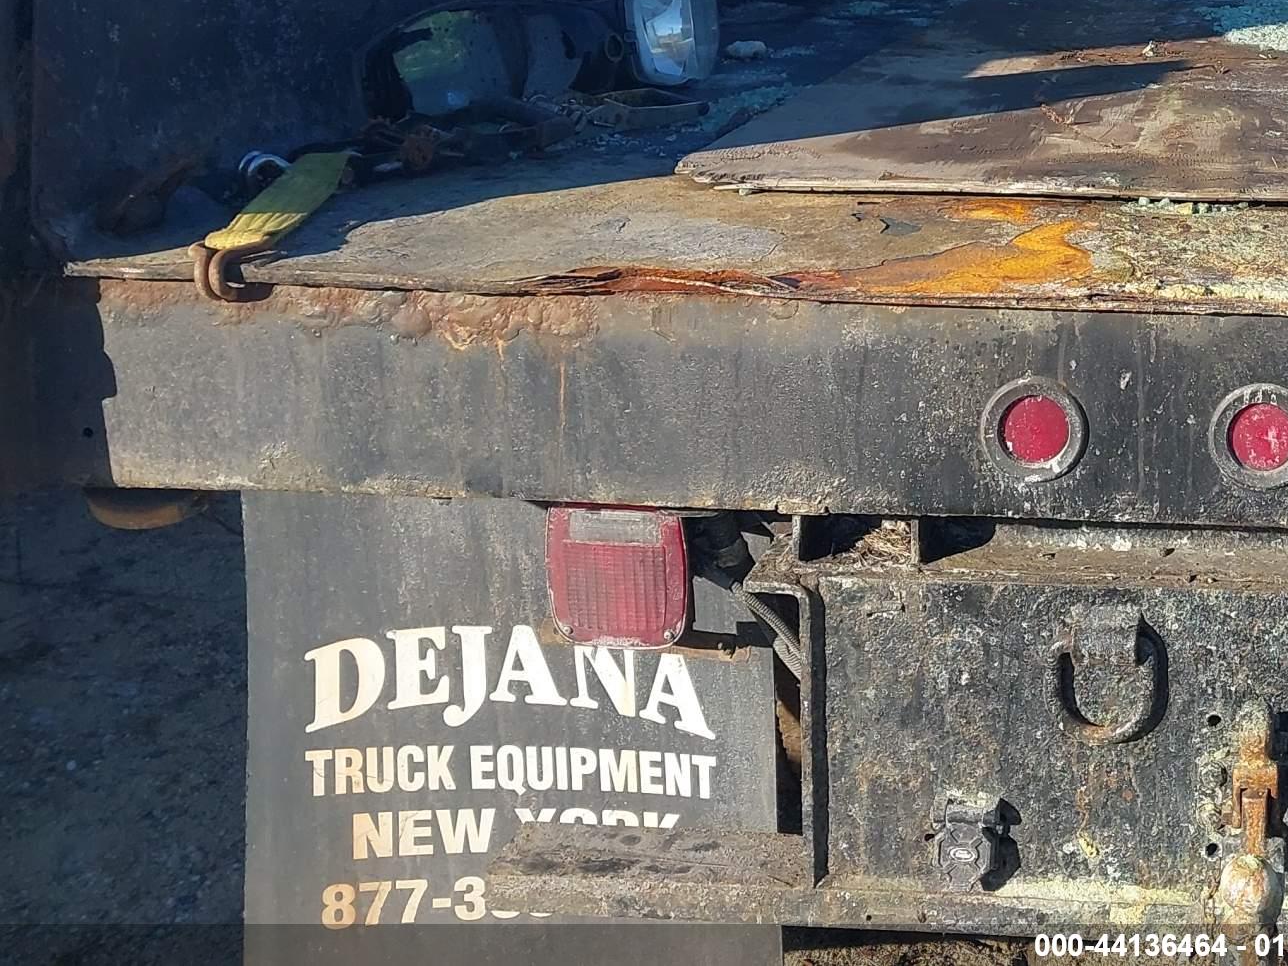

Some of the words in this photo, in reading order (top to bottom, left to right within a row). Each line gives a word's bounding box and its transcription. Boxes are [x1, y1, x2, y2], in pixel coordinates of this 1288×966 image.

[304, 624, 716, 740] DEJANA
[304, 745, 456, 797] TRUCK
[470, 745, 717, 800] EQUIPMENT
[352, 808, 496, 860] NEW
